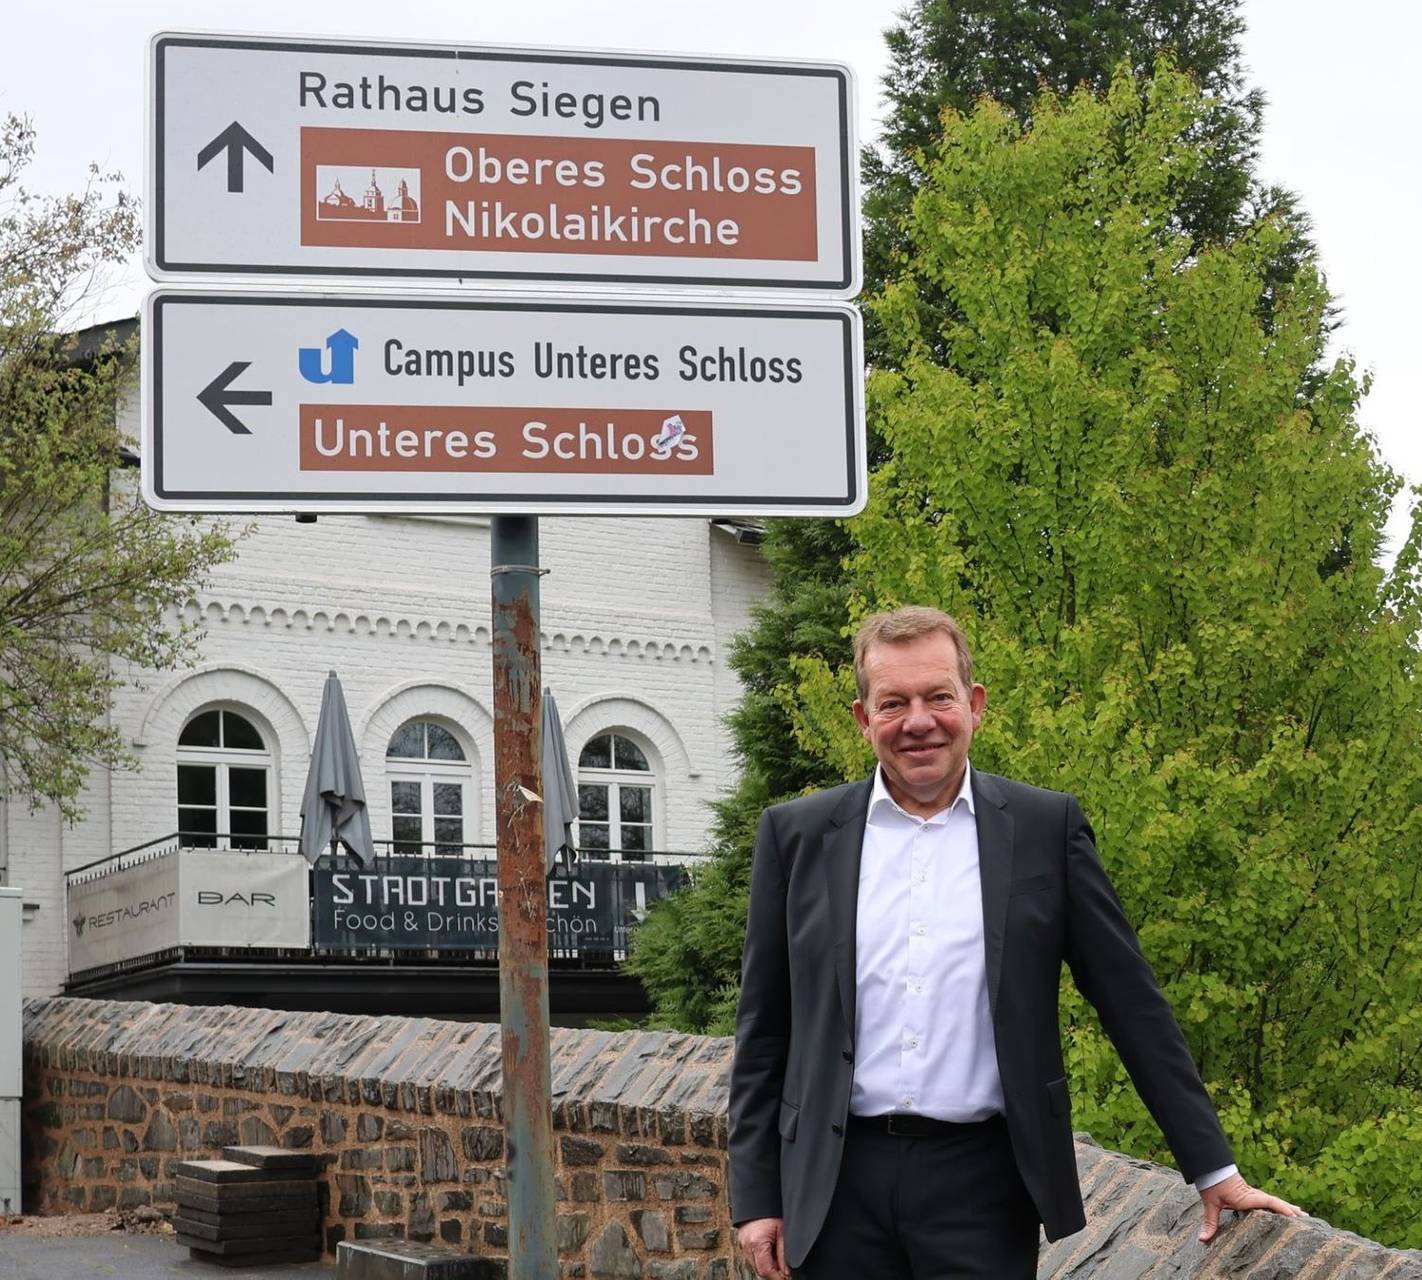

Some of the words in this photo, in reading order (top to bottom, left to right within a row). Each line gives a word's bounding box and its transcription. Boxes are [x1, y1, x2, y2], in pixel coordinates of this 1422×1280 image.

[300, 71, 484, 114] Rathaus
[510, 80, 659, 128] Siegen
[445, 146, 604, 187] Oberes
[630, 153, 801, 195] Schloss
[445, 200, 739, 245] Nikolaikirche
[384, 339, 514, 386] Campus
[534, 342, 659, 381] Unteres
[678, 345, 802, 383] Schloss
[315, 419, 496, 458] Unteres
[522, 420, 698, 460] Schloss
[88, 892, 176, 928] RESTAURANT
[198, 891, 275, 906] BAR
[332, 874, 595, 909] STADTGAEN
[333, 910, 394, 931] Food
[403, 911, 418, 931] &
[427, 912, 498, 932] Drinks
[545, 911, 596, 933] chön
